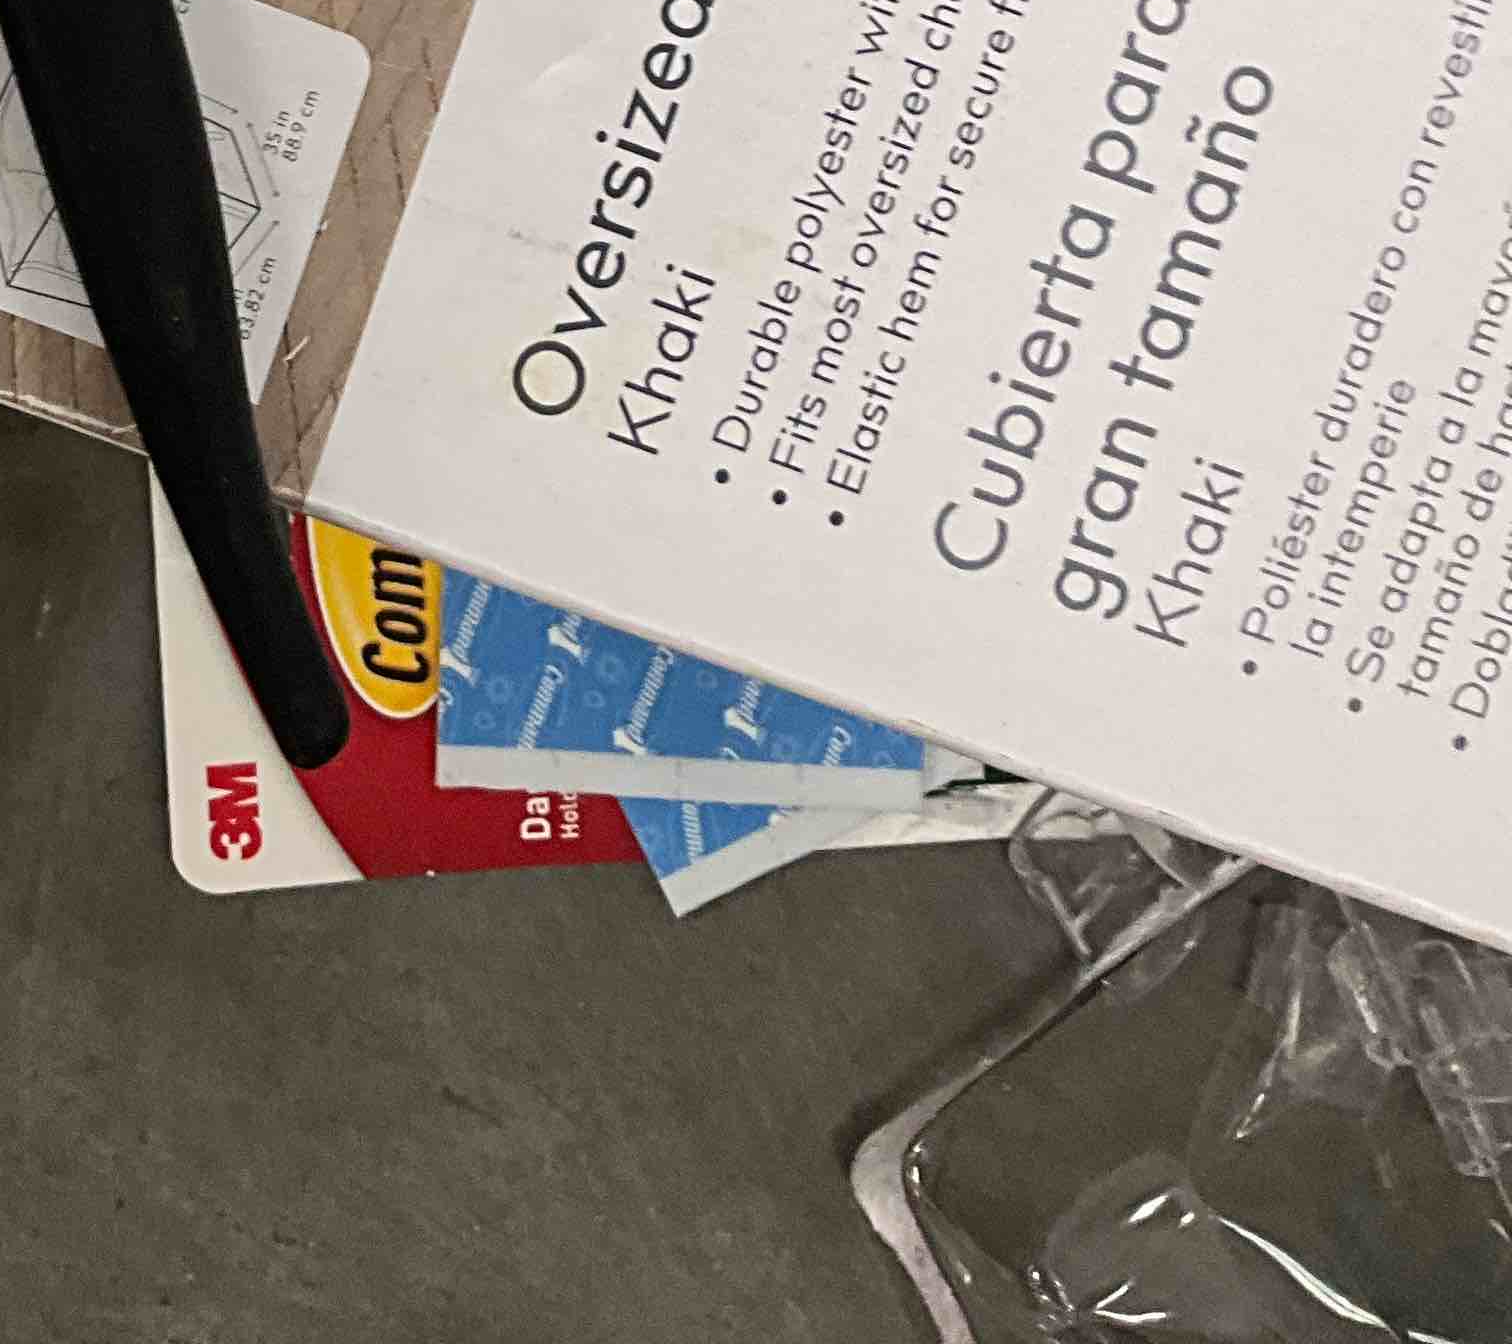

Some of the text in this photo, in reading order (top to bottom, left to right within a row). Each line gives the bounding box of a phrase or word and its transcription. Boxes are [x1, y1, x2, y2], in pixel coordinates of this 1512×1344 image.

[262, 111, 291, 155] 35 in
[283, 91, 320, 162] 88.9 cm
[256, 257, 277, 287] cm
[712, 280, 802, 454] Durable
[784, 66, 872, 274] polyester
[768, 394, 827, 474] Fits
[811, 275, 866, 384] most
[850, 57, 940, 270] oversized
[825, 351, 906, 496] Elastic
[877, 251, 942, 342] hem
[912, 174, 964, 238] for
[949, 30, 1015, 170] secure
[1053, 66, 1274, 620] gran tamaño
[606, 264, 717, 456] Khaki
[933, 204, 1116, 571] Cubierta
[1239, 451, 1336, 645] Poliéster
[1313, 246, 1405, 442] duradero
[1392, 160, 1438, 234] con
[1438, 367, 1485, 408] la
[1438, 417, 1467, 444] a
[1133, 457, 1245, 648] Khaki
[1288, 380, 1416, 658] la intemperie
[1380, 456, 1453, 613] adapta
[1396, 534, 1480, 697] tamaño
[1458, 468, 1504, 522] de
[361, 548, 430, 683] Com
[1345, 625, 1395, 683] Se
[204, 760, 263, 862] 3M
[520, 793, 552, 841] Da
